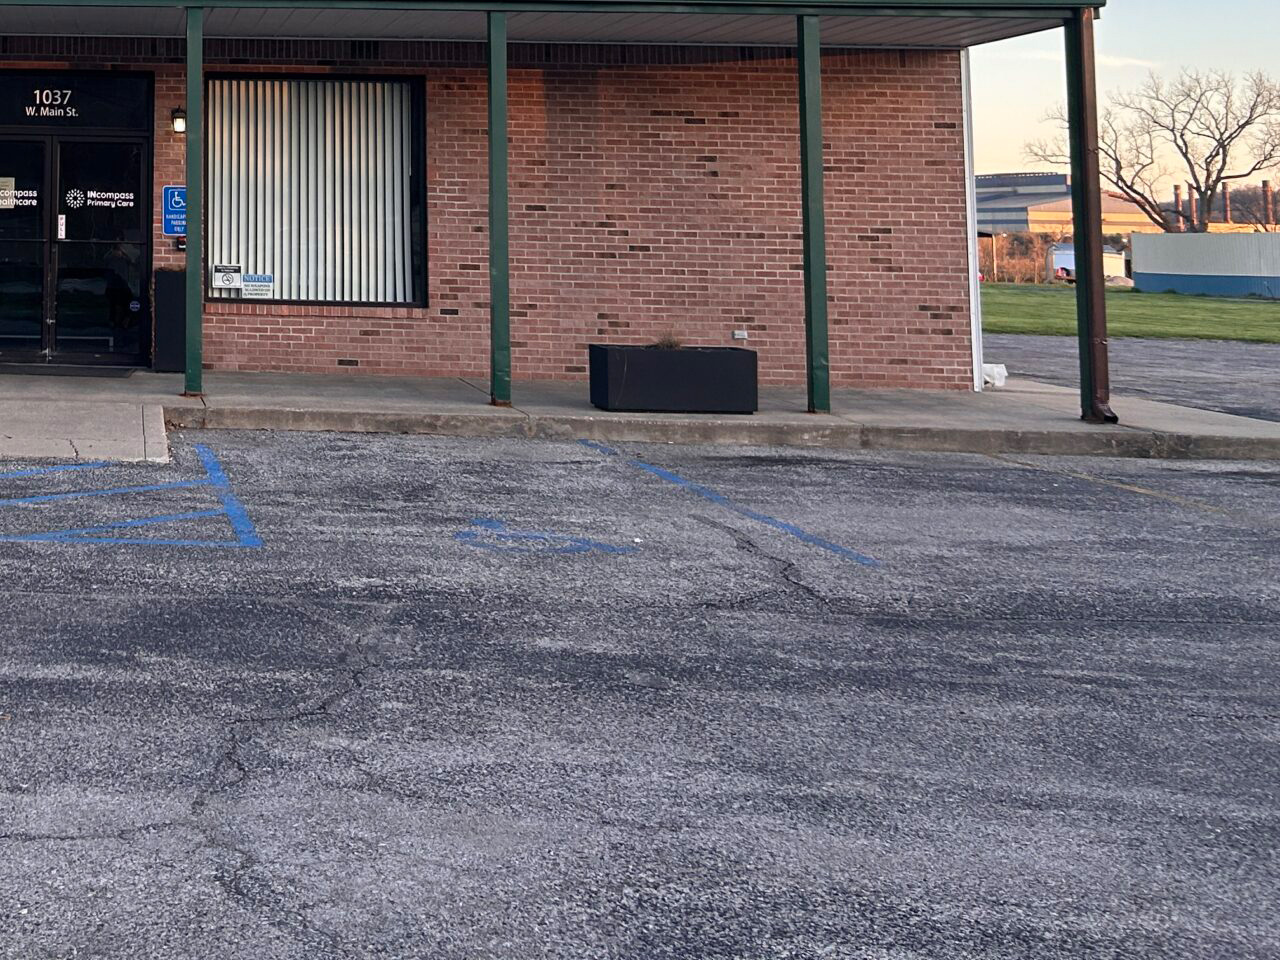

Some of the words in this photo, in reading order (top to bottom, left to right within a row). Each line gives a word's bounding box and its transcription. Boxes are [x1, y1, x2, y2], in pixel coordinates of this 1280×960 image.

[33, 89, 72, 105] 1037
[25, 106, 38, 117] W.
[40, 106, 64, 117] Main
[66, 106, 79, 117] St.
[87, 190, 134, 200] INcompass
[87, 199, 116, 208] Primary
